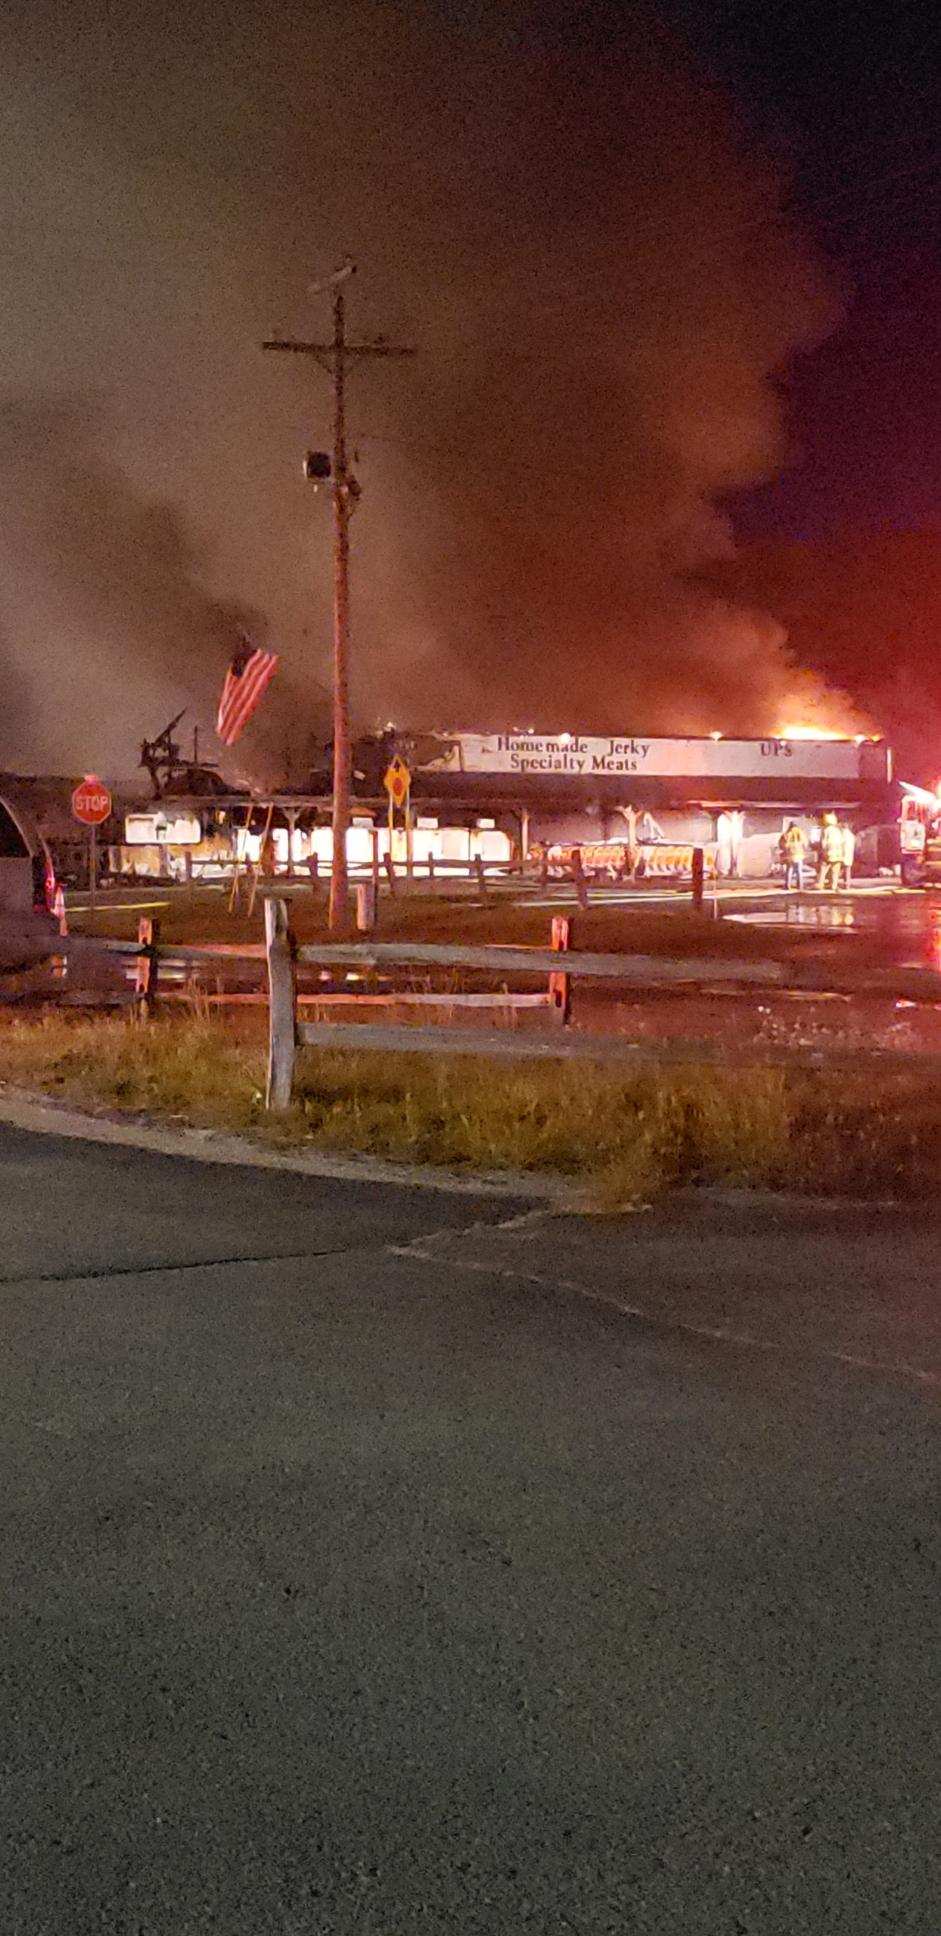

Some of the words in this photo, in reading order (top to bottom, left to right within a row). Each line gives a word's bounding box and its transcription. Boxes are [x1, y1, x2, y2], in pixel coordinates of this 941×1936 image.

[608, 739, 650, 758] Jerky
[760, 741, 792, 757] UPS
[510, 753, 585, 772] Specialty
[591, 755, 638, 771] Meats
[75, 795, 109, 811] STOP
